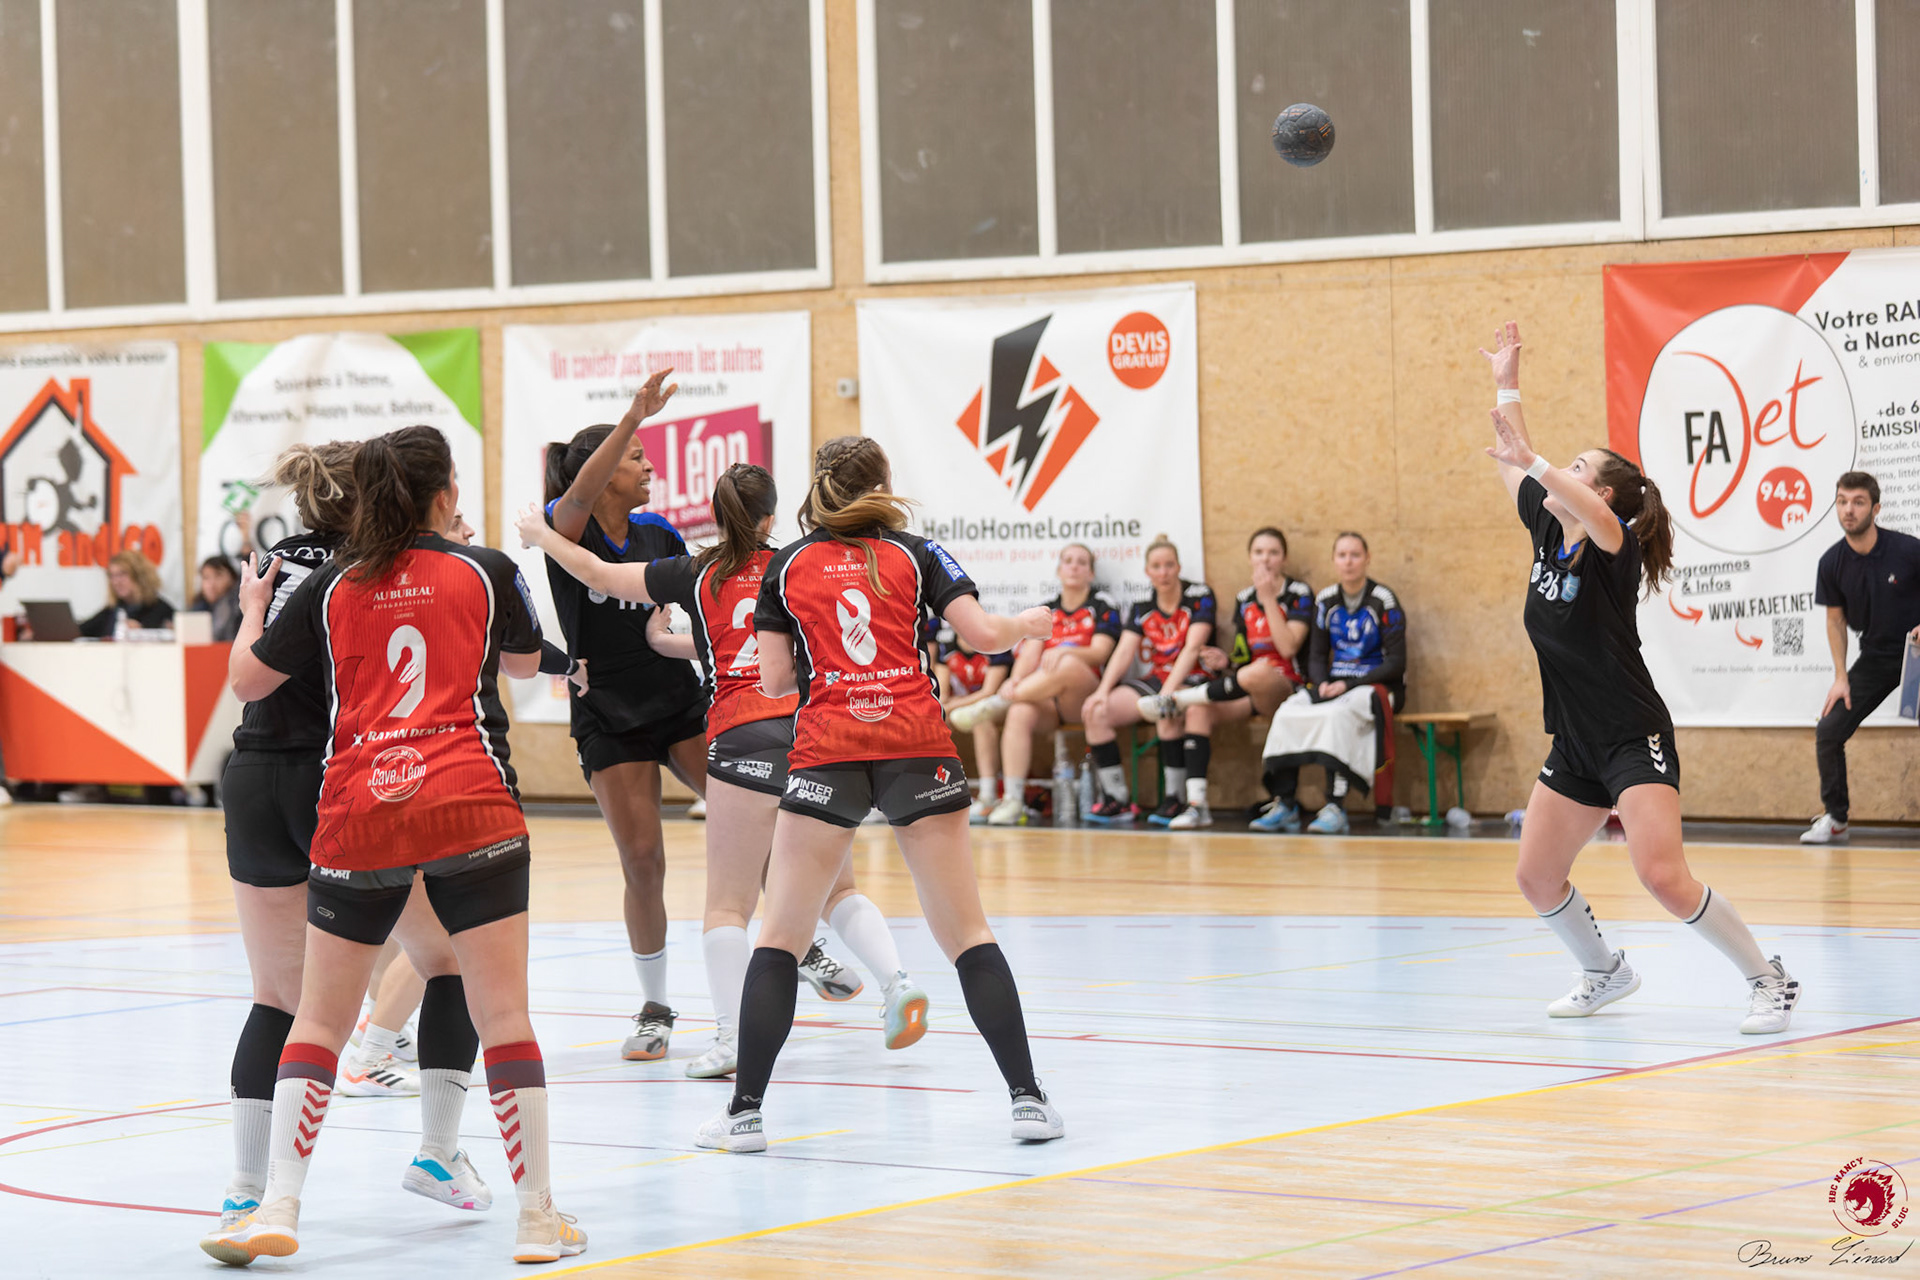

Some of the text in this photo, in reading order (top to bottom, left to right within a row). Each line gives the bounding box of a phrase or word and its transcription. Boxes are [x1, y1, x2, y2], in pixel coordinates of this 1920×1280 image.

[1814, 310, 1879, 331] Votre
[1111, 330, 1168, 354] DEVIS
[1844, 333, 1858, 352] à
[1112, 352, 1167, 370] GRATUIT
[1858, 355, 1868, 369] &
[1760, 479, 1806, 502] 94.2
[1787, 511, 1805, 525] FM
[921, 514, 1141, 542] HelloHomeLorraine
[951, 546, 1006, 563] olution
[823, 562, 868, 573] AU BUREA
[1668, 559, 1751, 583] rogrammes
[373, 586, 435, 602] AU BUREAU
[1537, 570, 1560, 601] 26
[1696, 578, 1732, 592] Infos
[1708, 592, 1815, 621] WWW.FAJET.NET
[836, 588, 878, 666] 8
[387, 624, 427, 718] 9
[876, 667, 900, 680] DEM
[901, 665, 914, 676] 54
[850, 693, 894, 710] Cave Léon
[367, 728, 409, 742] RAYAN
[438, 722, 457, 734] 54
[371, 767, 397, 786] Cave
[401, 762, 427, 783] Léon
[736, 764, 773, 780] SPORT
[796, 788, 831, 805] SPORT
[800, 778, 833, 797] INTER
